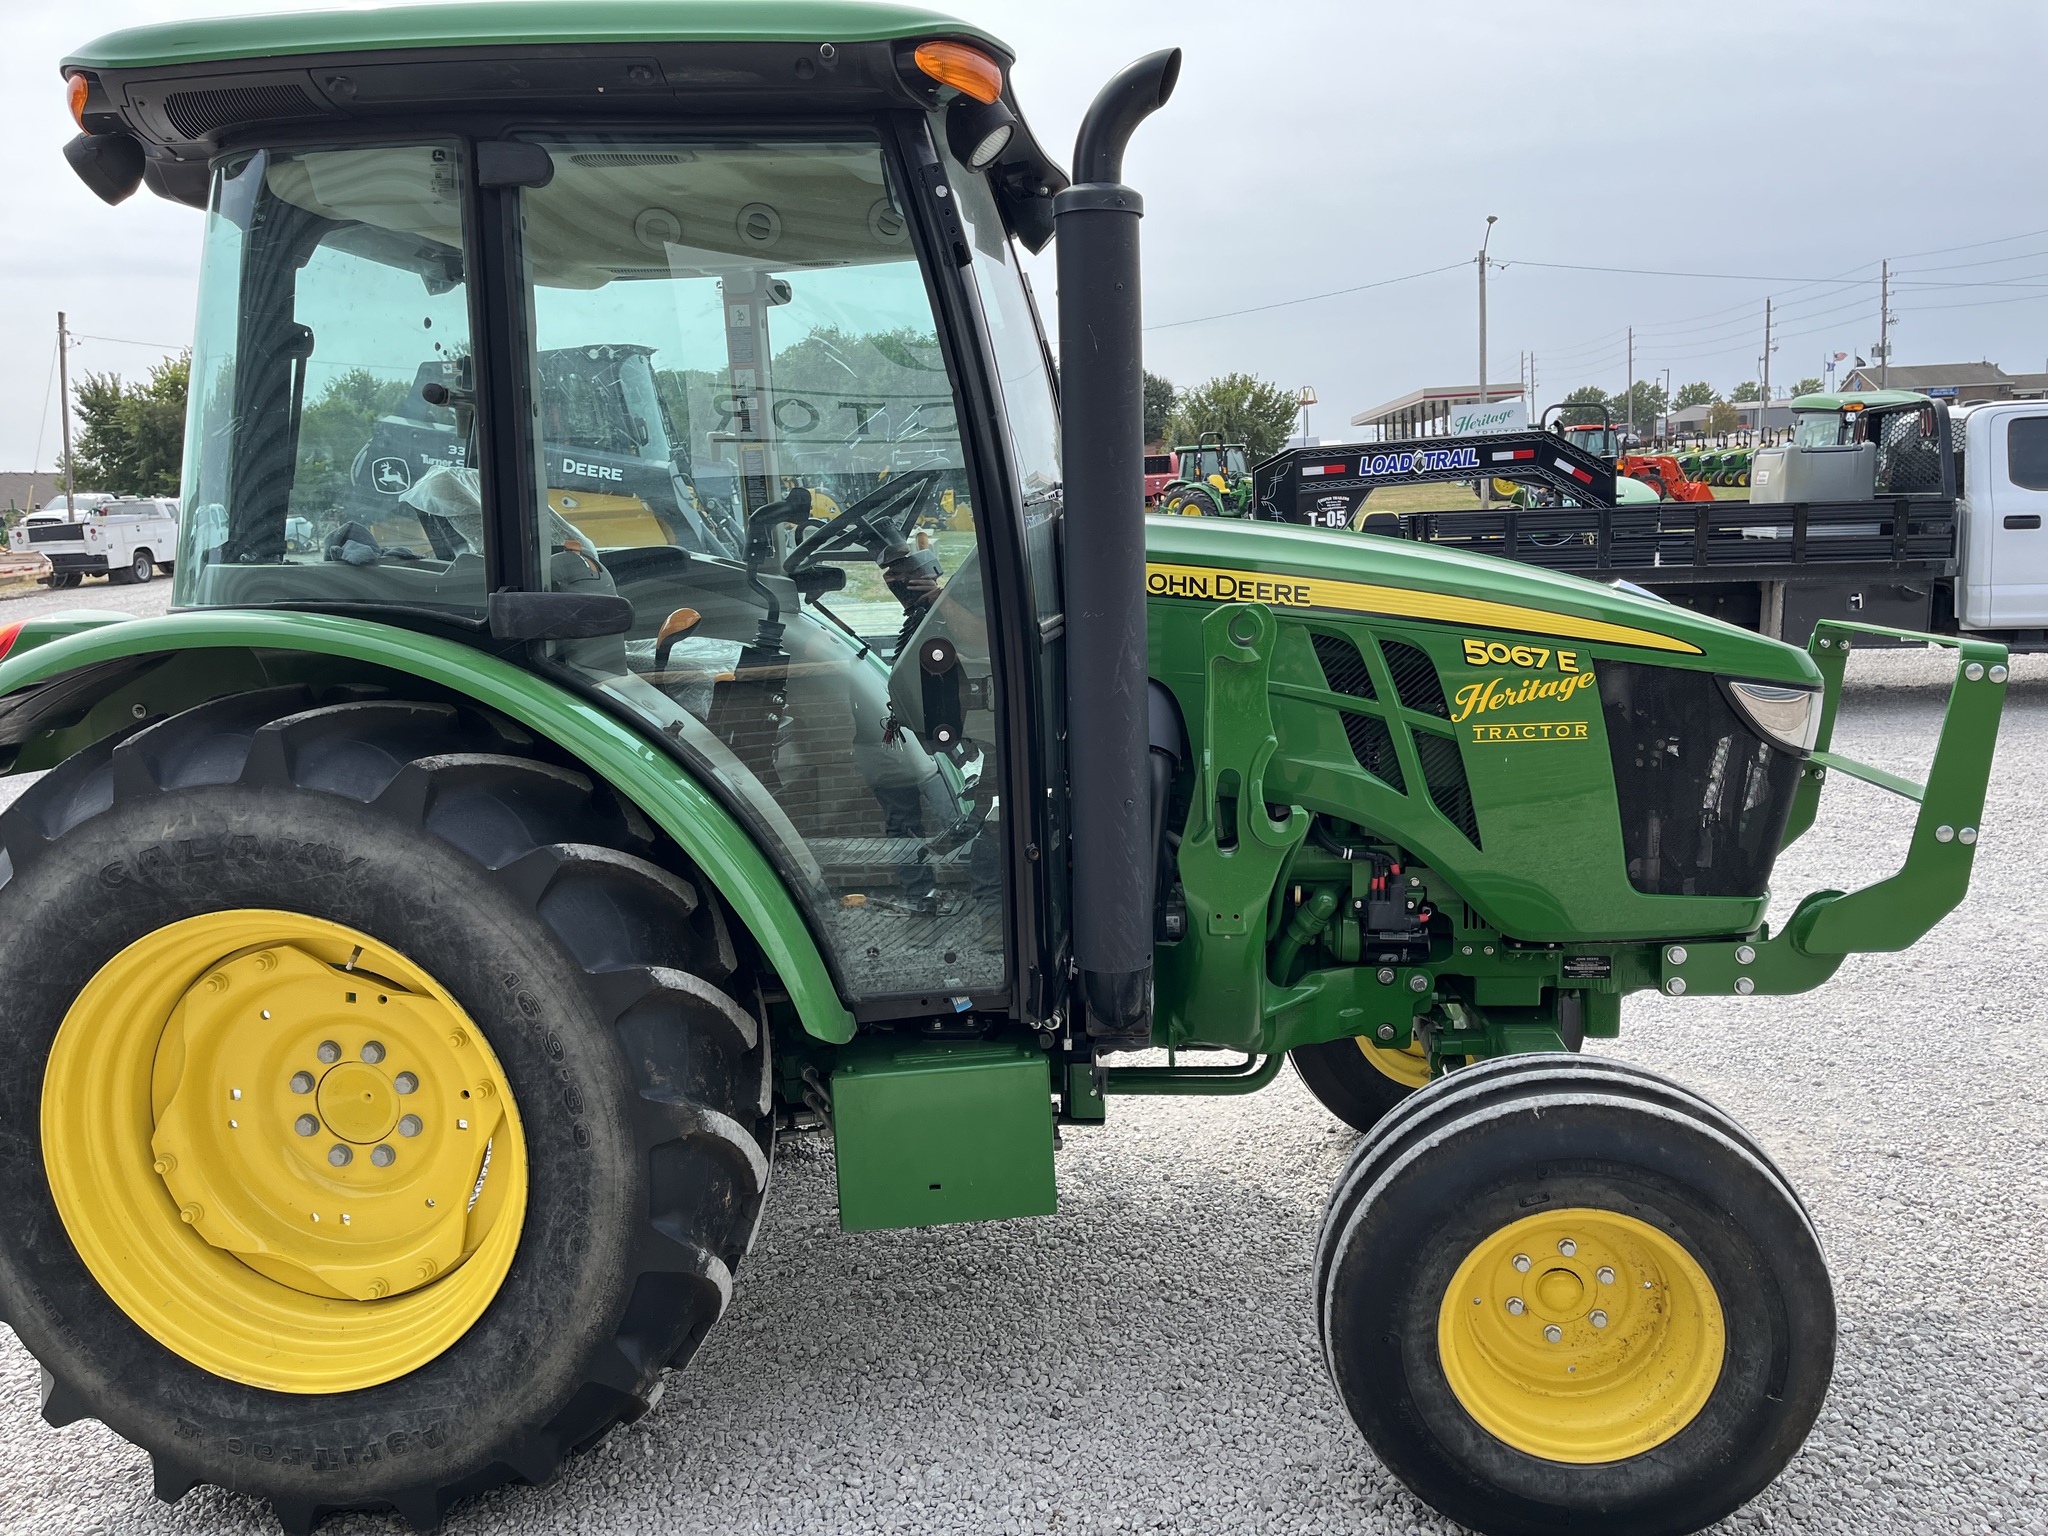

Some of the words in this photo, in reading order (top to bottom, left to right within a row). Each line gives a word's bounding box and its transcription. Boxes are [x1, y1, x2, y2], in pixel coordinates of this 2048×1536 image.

[1453, 409, 1515, 436] Heritage
[448, 445, 466, 456] 33
[1359, 453, 1413, 476] LOAD
[1424, 447, 1480, 470] TRAIL
[562, 458, 623, 481] DEERE
[1308, 510, 1346, 528] T-05
[1148, 573, 1207, 595] OHN
[1215, 574, 1311, 604] DEERE
[1461, 638, 1551, 670] 5067
[1556, 649, 1580, 674] E
[1450, 671, 1597, 723] Heritage
[1472, 723, 1589, 741] TRACTOR
